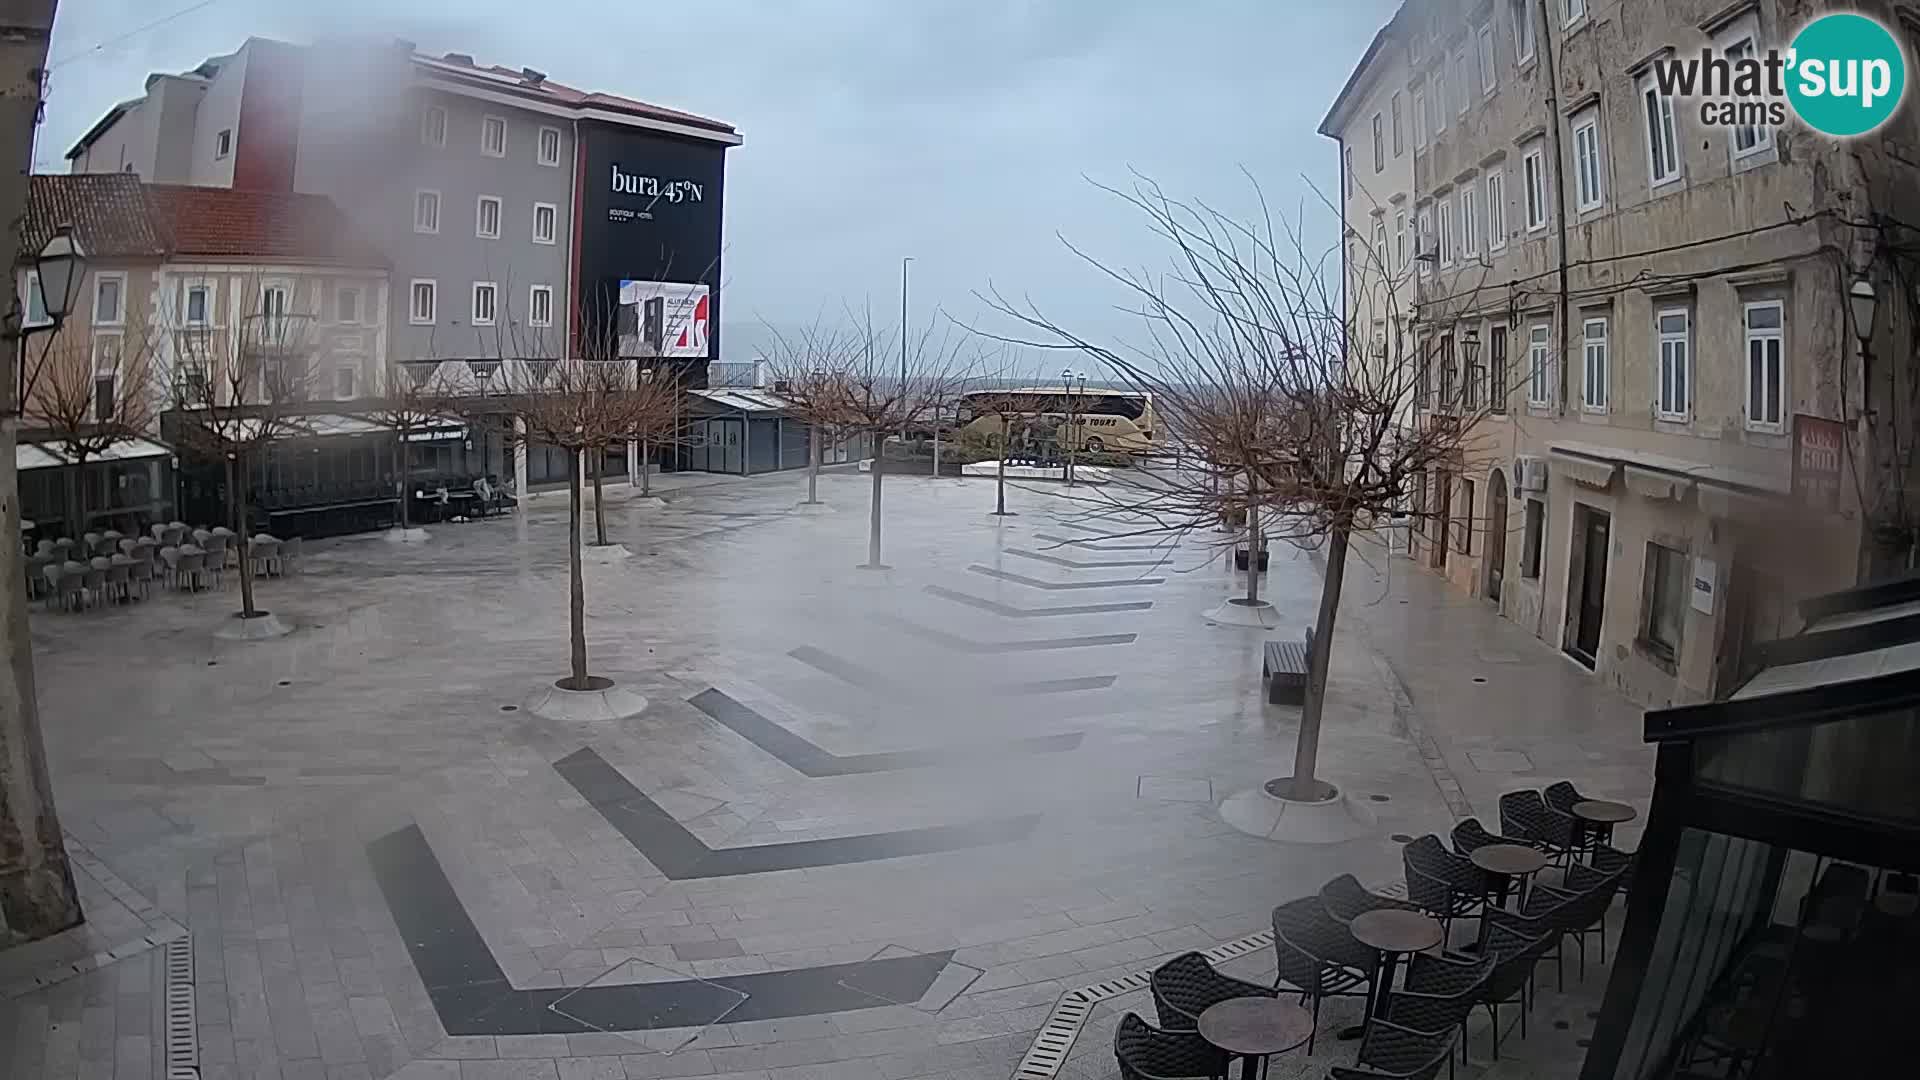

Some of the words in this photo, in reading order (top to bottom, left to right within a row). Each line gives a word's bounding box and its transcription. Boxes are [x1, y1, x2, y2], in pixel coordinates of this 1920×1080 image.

[612, 165, 659, 197] bura
[609, 208, 634, 217] BOUTIQUE
[638, 211, 653, 219] HOTEL
[1090, 418, 1116, 426] TOURS
